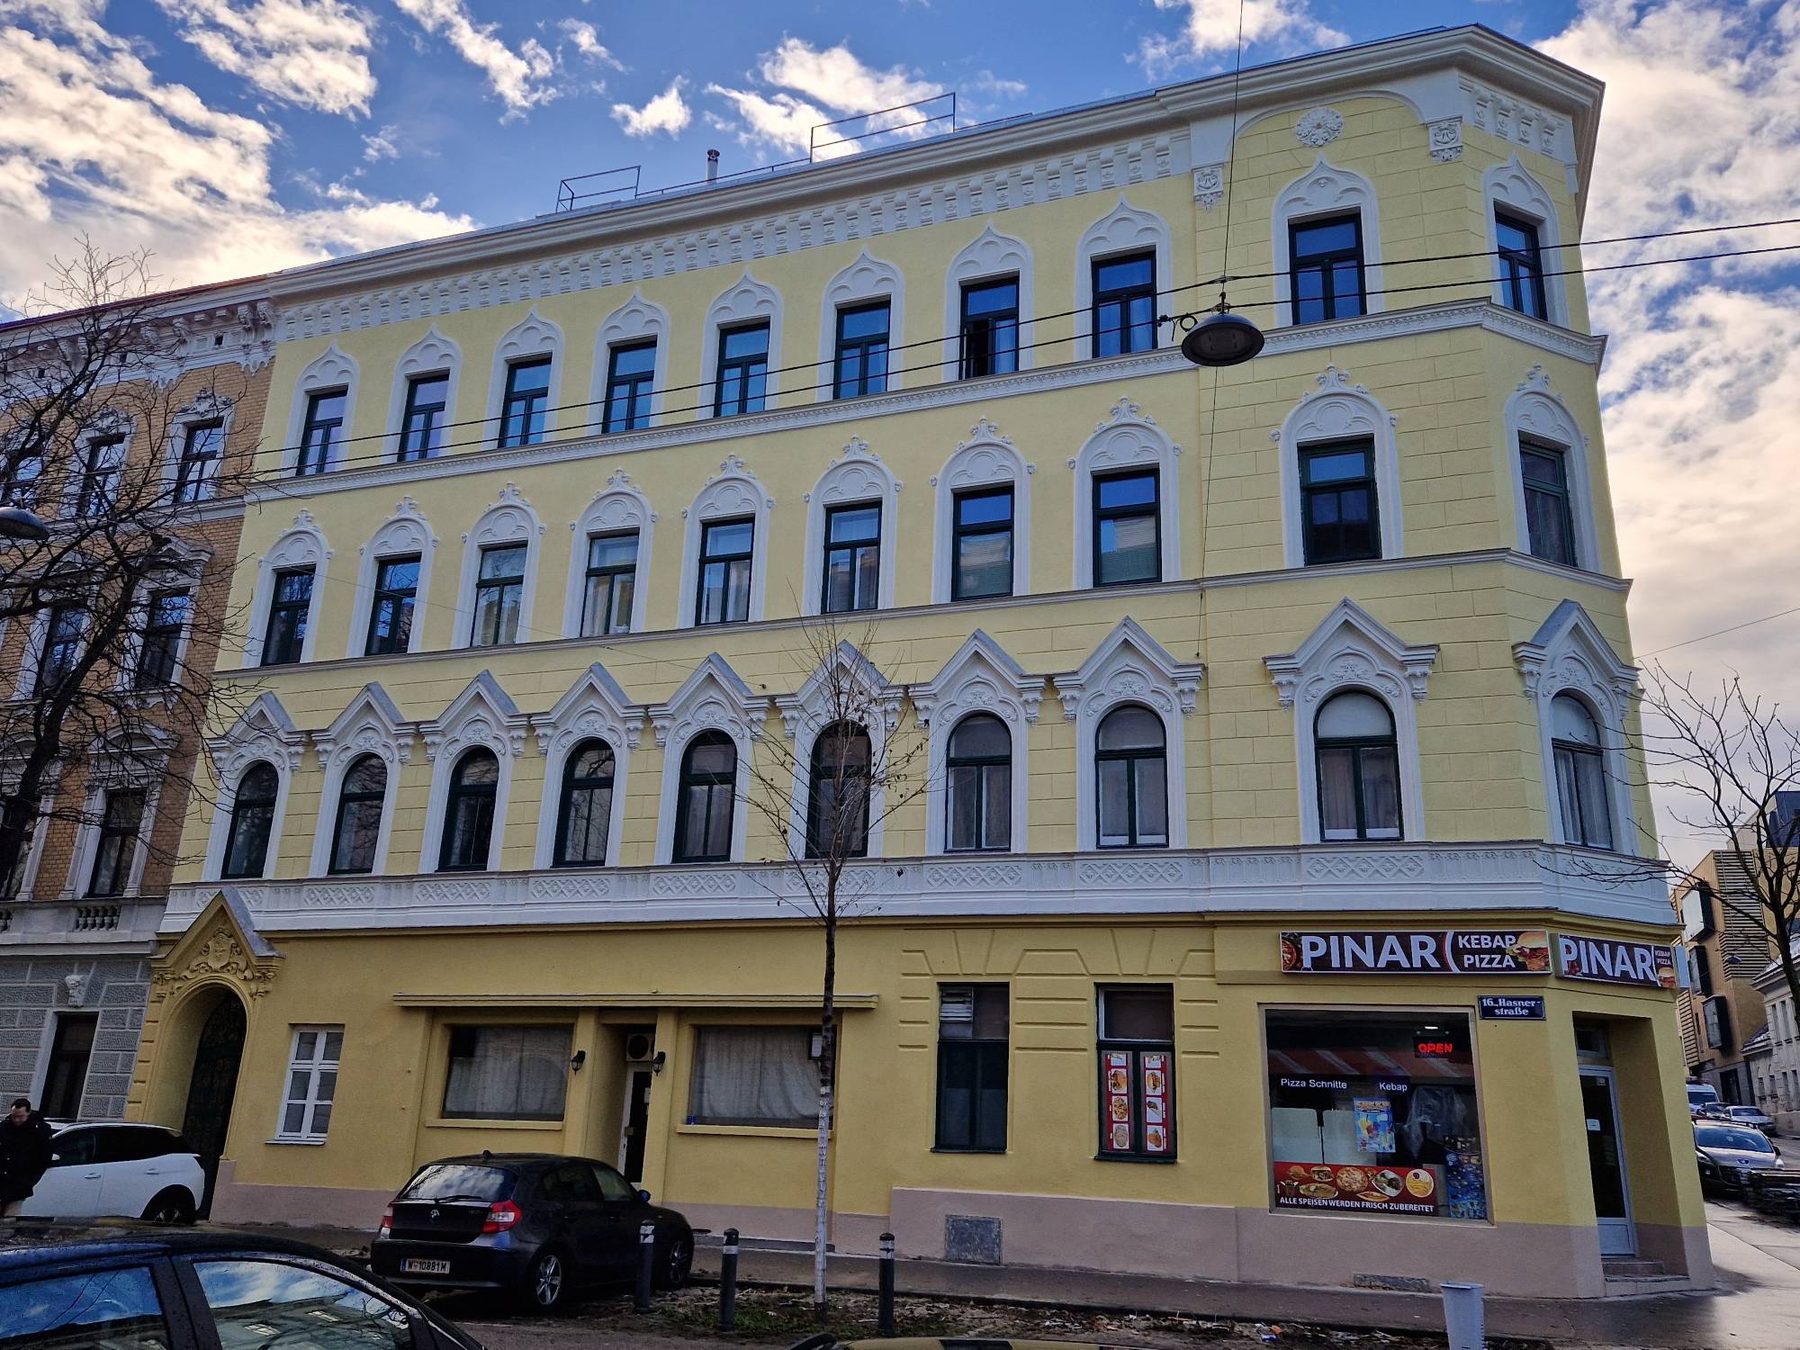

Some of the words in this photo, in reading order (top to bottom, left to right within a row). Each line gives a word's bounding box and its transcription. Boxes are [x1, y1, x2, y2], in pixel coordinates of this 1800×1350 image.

[1458, 935, 1516, 949] KEBAP
[1300, 935, 1440, 968] PINAR
[1463, 954, 1516, 968] PIZZA
[1559, 938, 1656, 982] PINAR
[1494, 1006, 1529, 1016] straße
[1418, 1042, 1453, 1053] OPEN
[1280, 1078, 1306, 1087] Pizza
[1308, 1079, 1348, 1089] Schnitte
[1379, 1082, 1408, 1092] Kebap
[1280, 1197, 1297, 1205] ALLE
[1298, 1198, 1329, 1206] SPEISEN
[1328, 1199, 1360, 1208] WERDEN
[1361, 1201, 1388, 1210] FRISCH
[1389, 1203, 1434, 1212] ZUBEREITET
